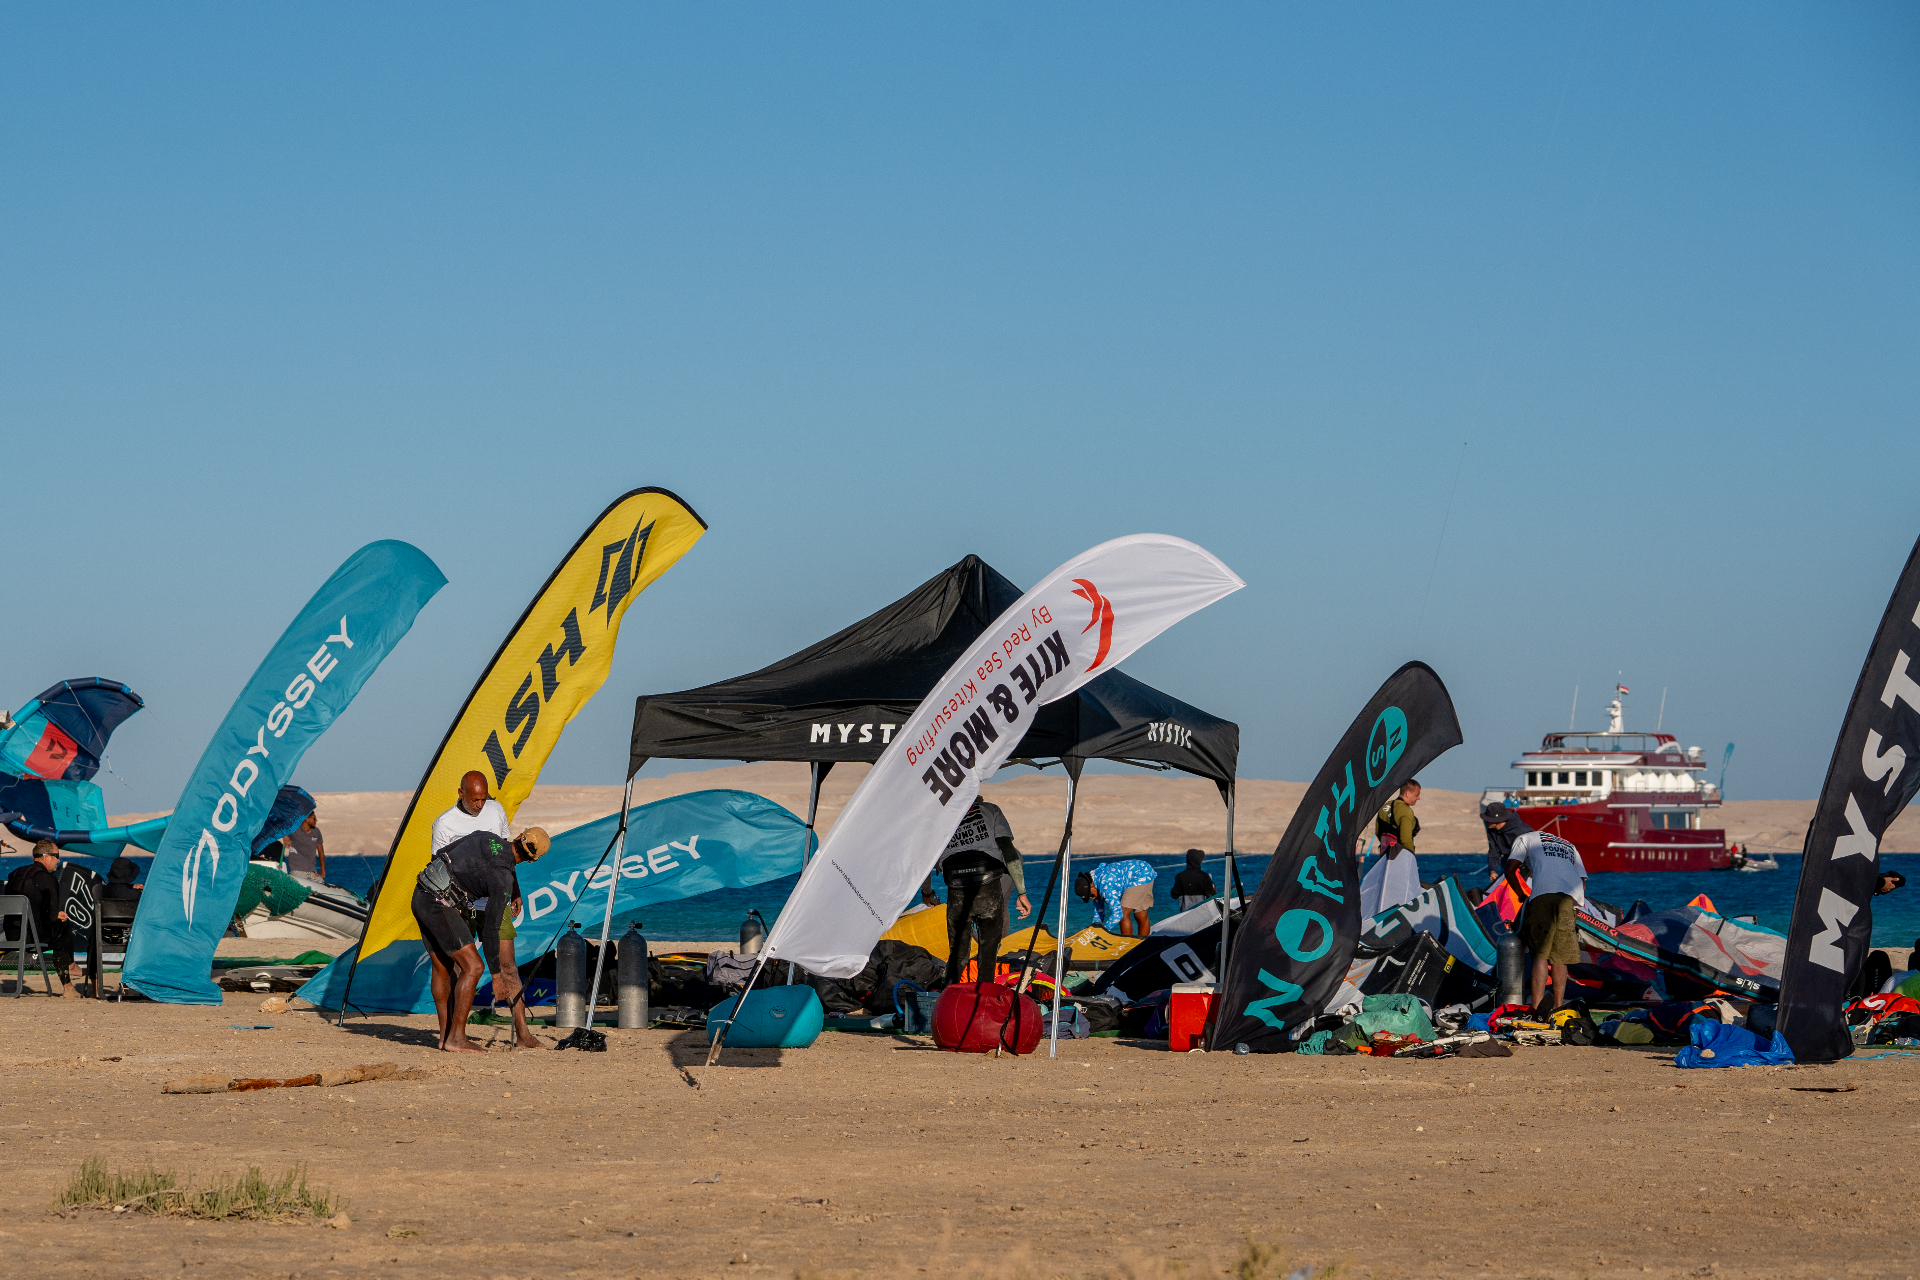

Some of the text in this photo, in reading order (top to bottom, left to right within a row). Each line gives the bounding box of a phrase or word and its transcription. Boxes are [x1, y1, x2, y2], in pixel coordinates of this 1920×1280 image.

[211, 614, 354, 833] ODYSSEY
[481, 606, 588, 791] ISH
[906, 605, 1053, 765] By Red Sea Kitesurfing
[921, 629, 1071, 807] KITE & MORE
[810, 723, 905, 744] MYST
[1147, 722, 1192, 749] MYSTIC
[951, 824, 987, 843] OUND IN
[1808, 600, 1920, 975] MYST
[960, 837, 975, 846] RED
[1543, 845, 1569, 855] FOUND
[1242, 759, 1357, 1031] NORTH
[1576, 910, 1609, 932] DUOTONE
